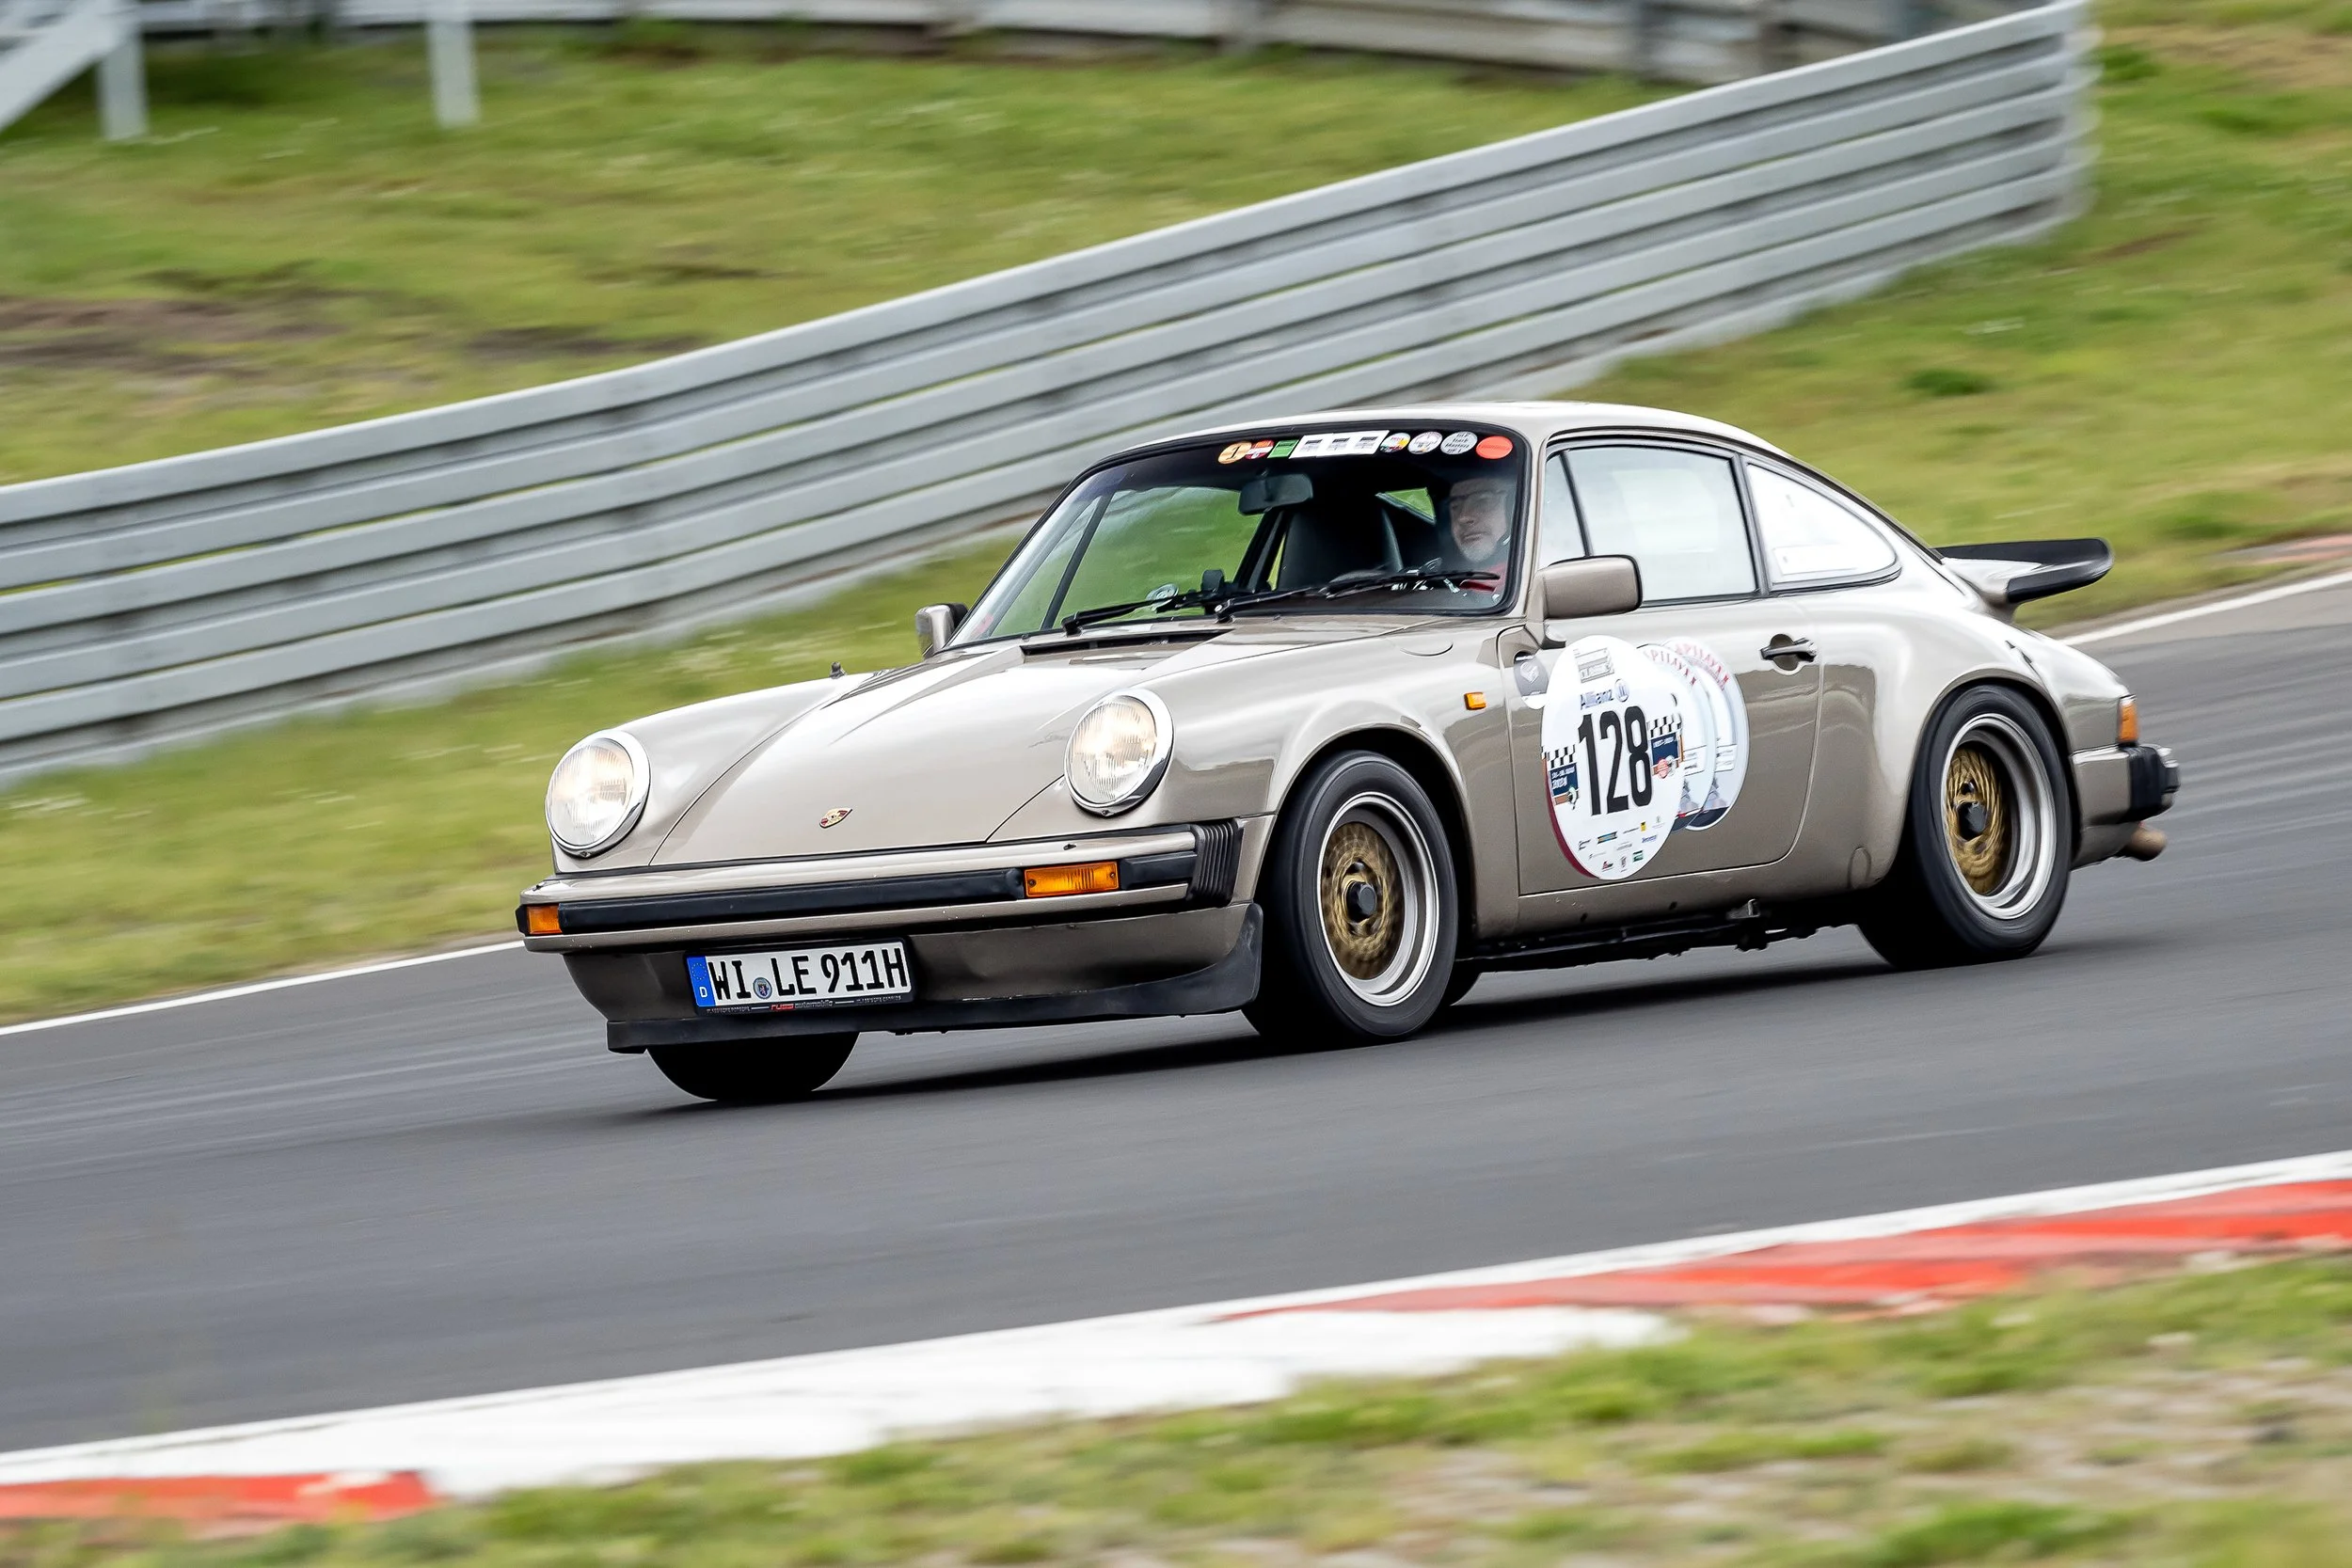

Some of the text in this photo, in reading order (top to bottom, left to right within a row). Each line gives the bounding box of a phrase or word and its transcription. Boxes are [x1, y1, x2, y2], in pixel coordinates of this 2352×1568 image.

[1225, 445, 1241, 461] 1
[1578, 705, 1652, 816] 128
[707, 947, 908, 1001] WI LE 911H
[698, 986, 707, 998] D
